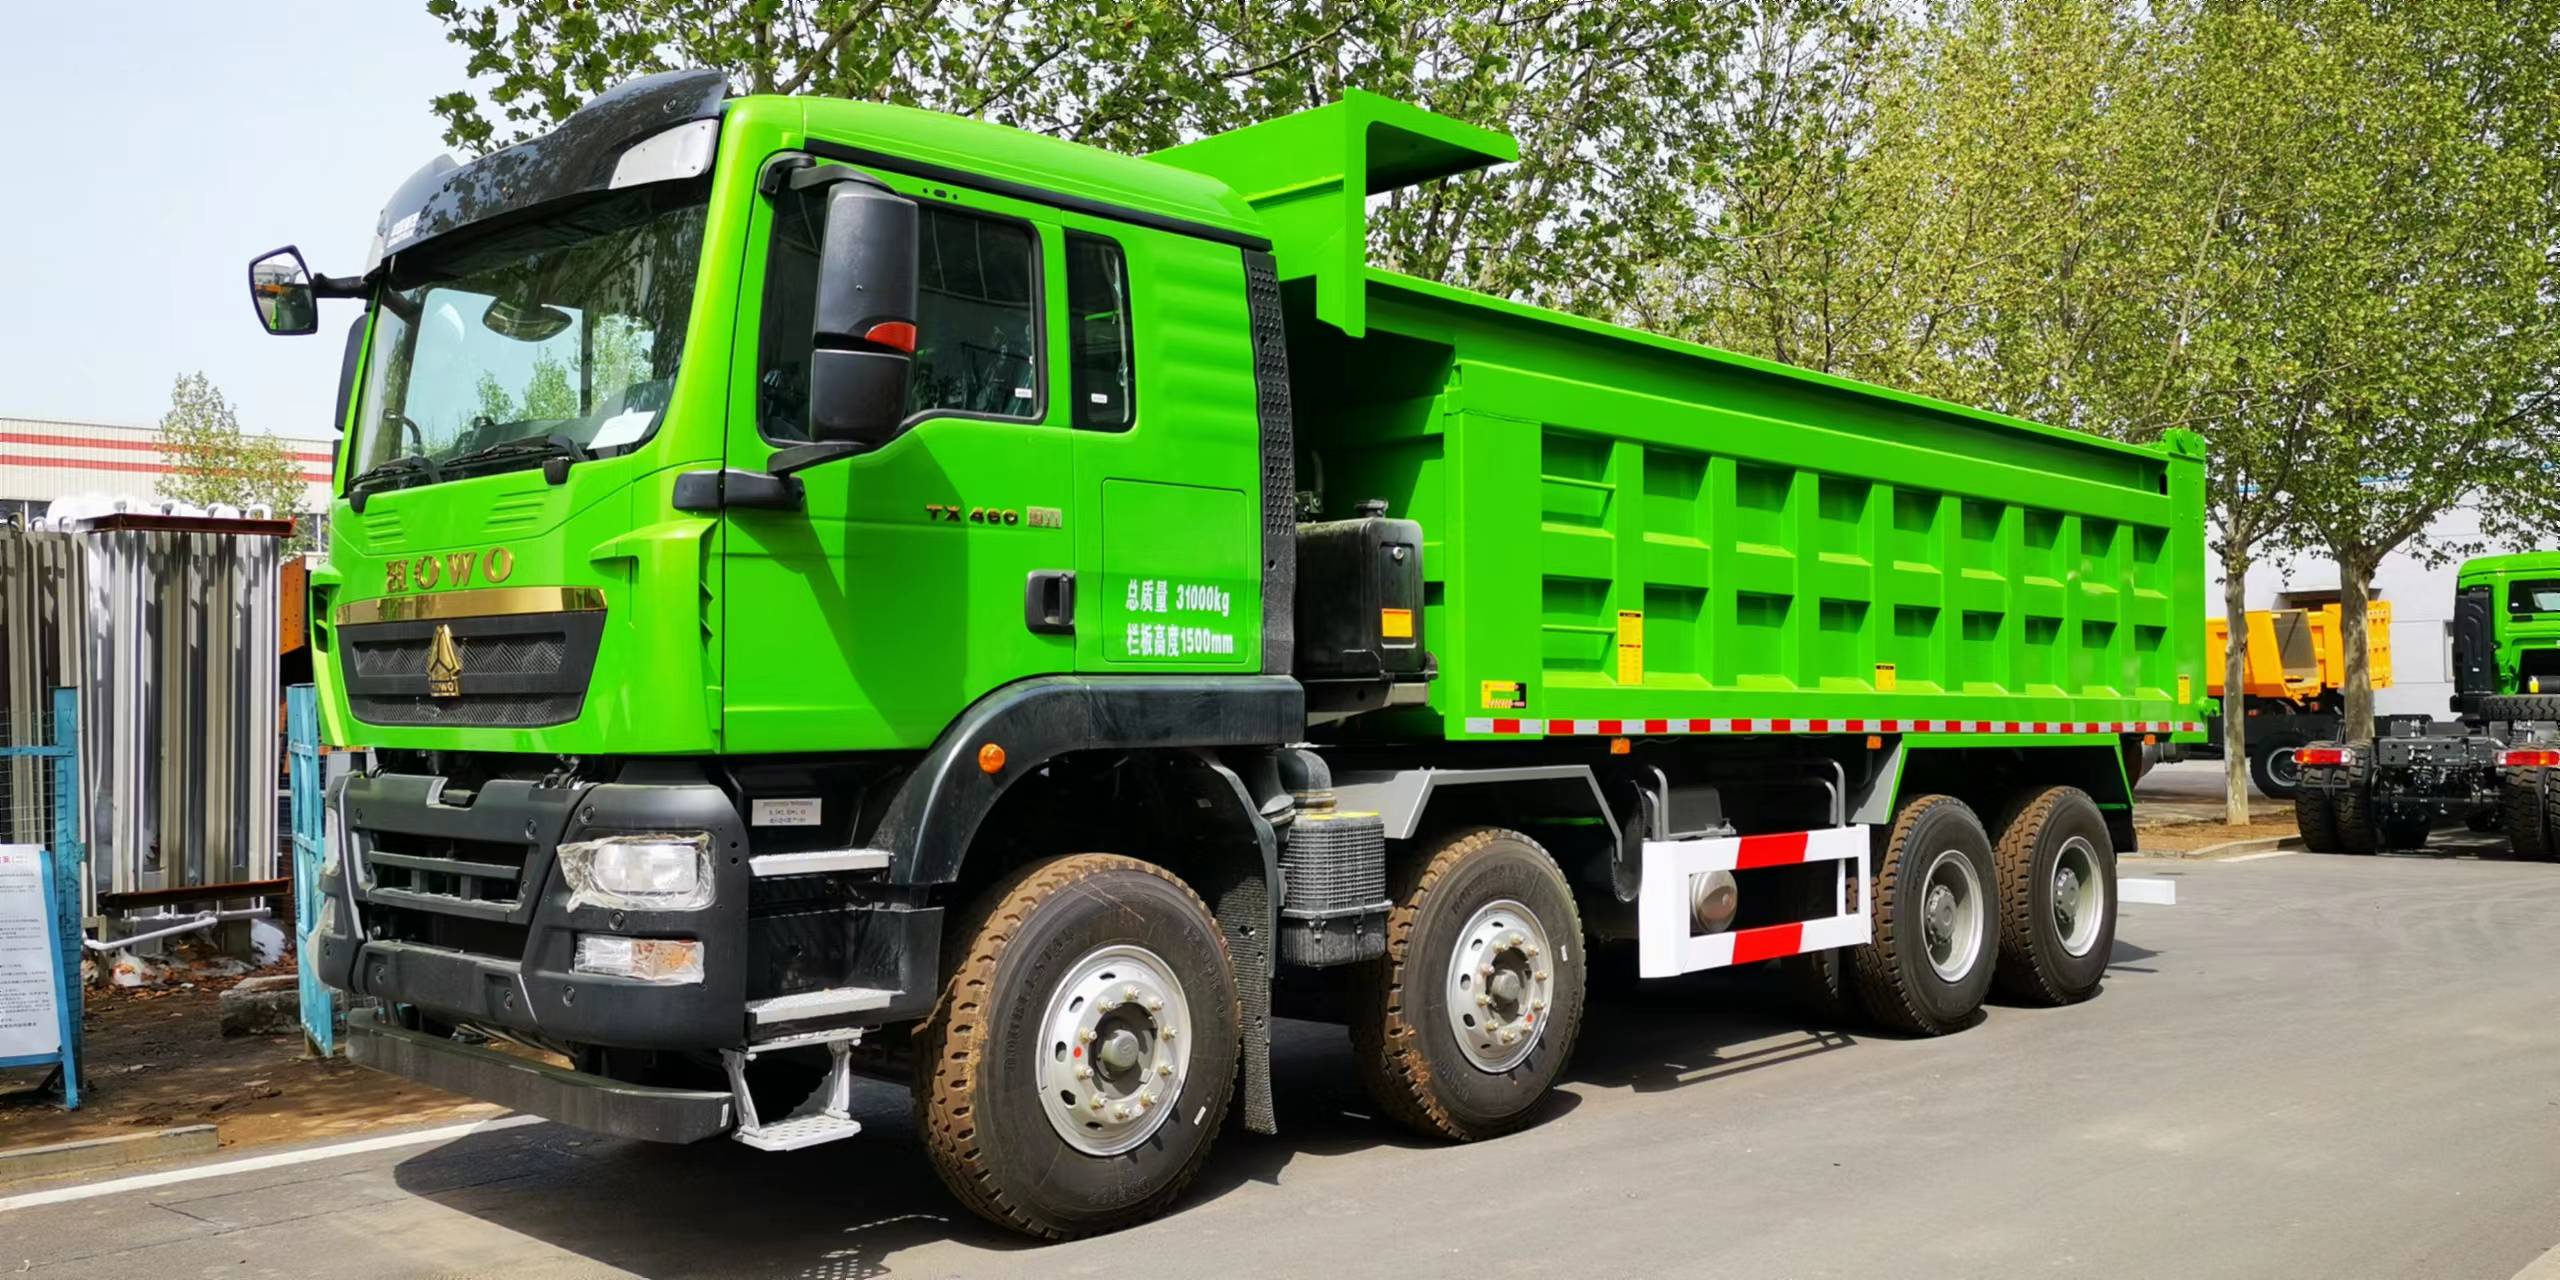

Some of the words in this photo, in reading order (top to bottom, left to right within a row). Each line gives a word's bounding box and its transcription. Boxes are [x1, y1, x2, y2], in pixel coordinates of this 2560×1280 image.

[926, 503, 960, 522] TX
[969, 507, 1019, 525] 460
[385, 547, 514, 593] HOWO
[1126, 579, 1168, 613] 总质量
[1176, 584, 1230, 617] 31000kg
